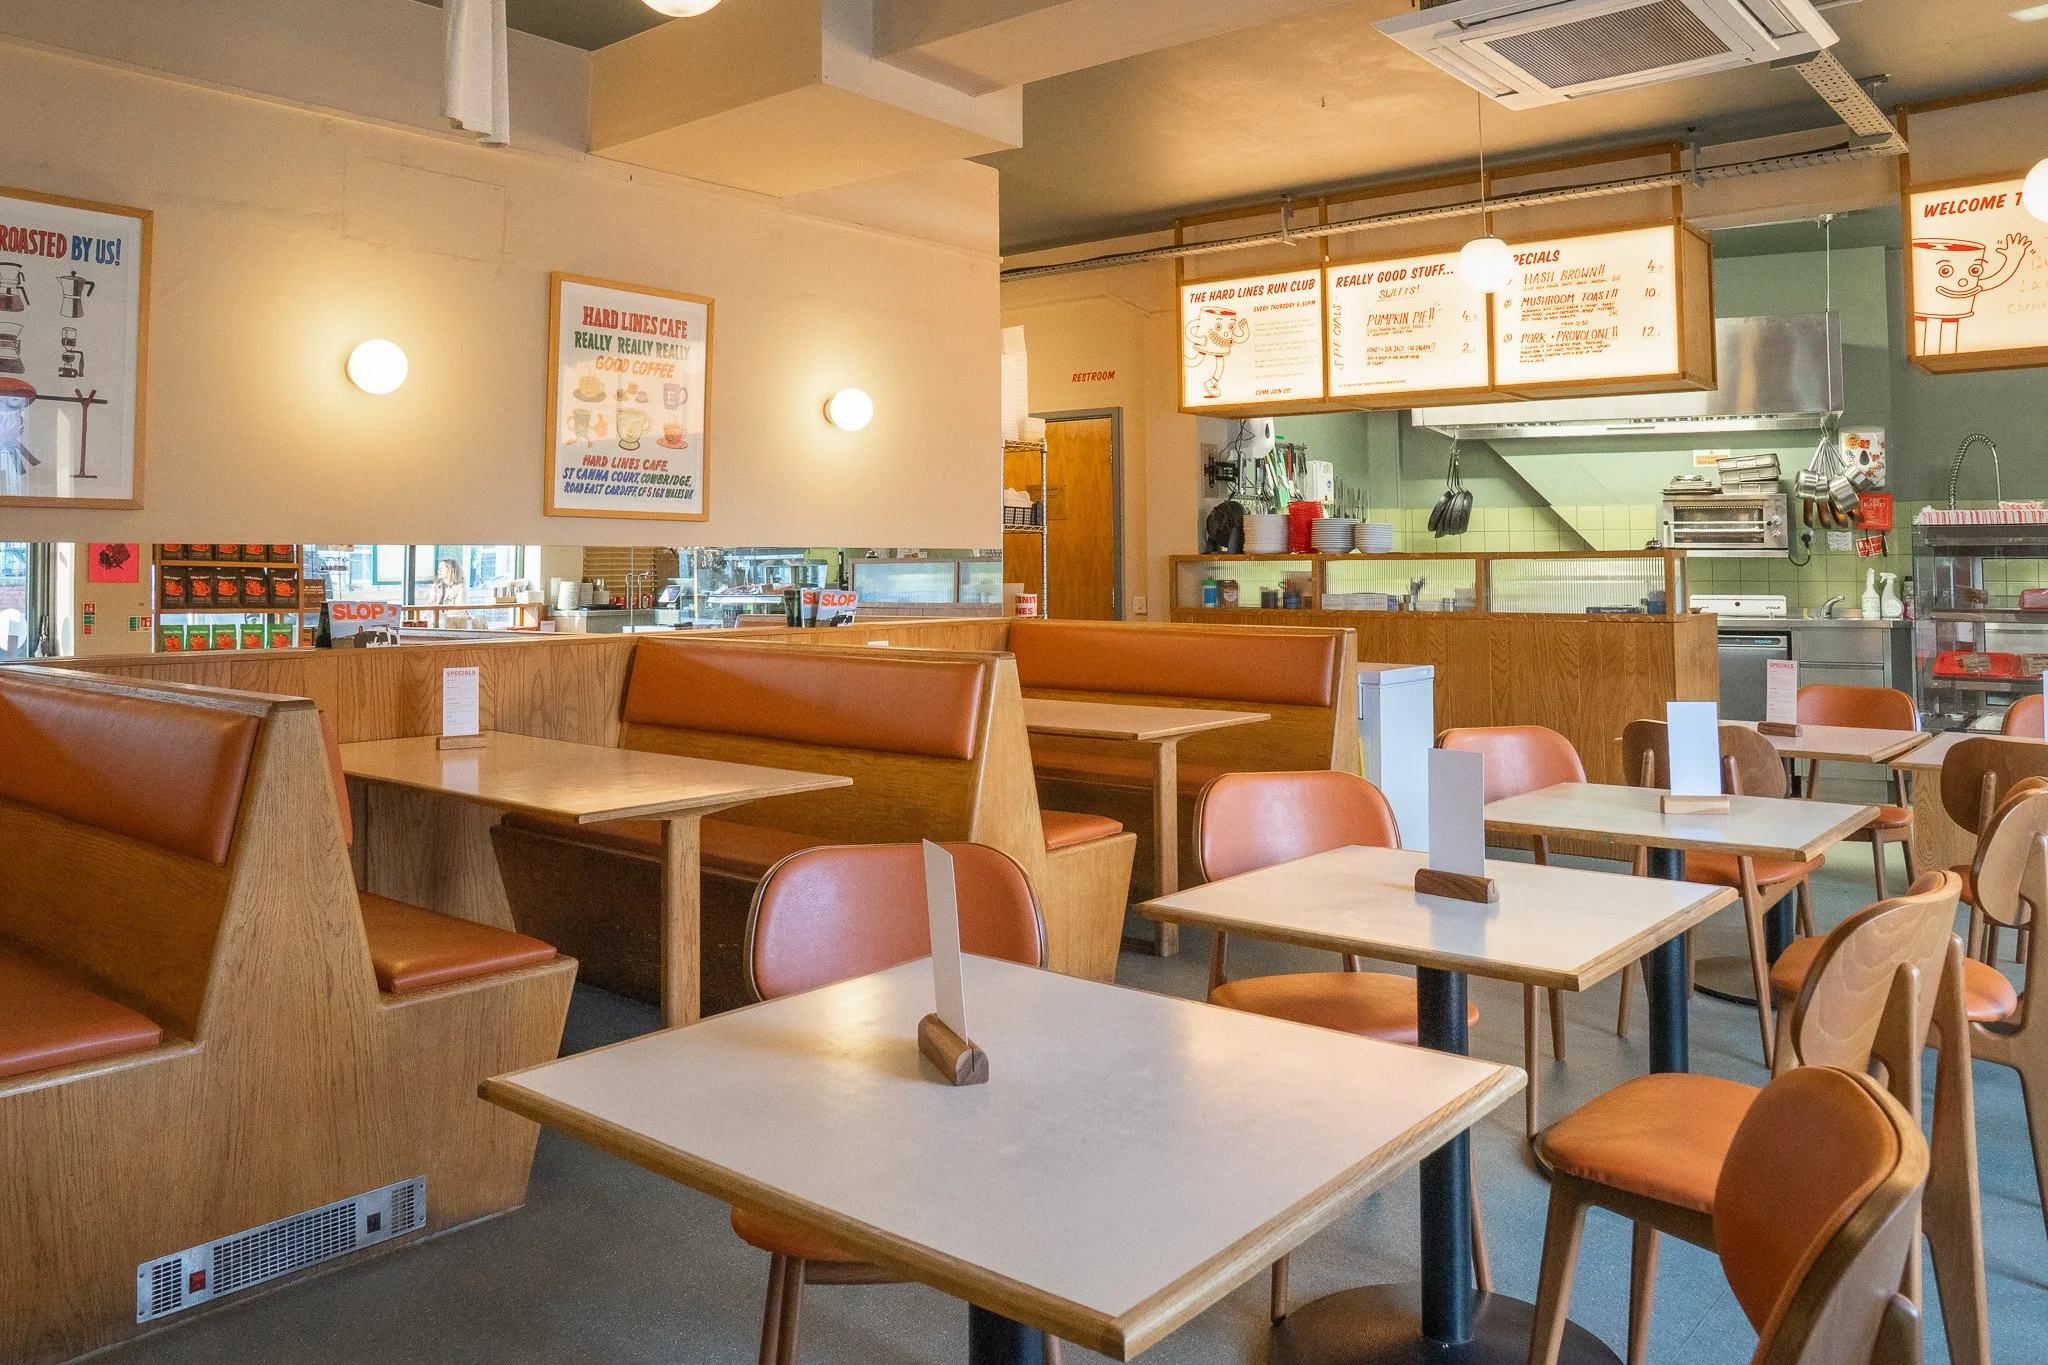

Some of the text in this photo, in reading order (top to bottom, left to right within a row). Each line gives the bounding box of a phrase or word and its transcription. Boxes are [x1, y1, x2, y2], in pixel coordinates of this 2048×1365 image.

[1923, 194, 2007, 218] WELCOME
[0, 224, 122, 266] ROASTED BY US!
[1513, 250, 1560, 266] PECIALS
[1336, 264, 1454, 288] REALLY GOOD STUFF...
[1524, 271, 1554, 285] HASH
[1560, 264, 1606, 282] BROWN!!
[1190, 278, 1316, 304] THE HARD LINES RUN CLUB
[1378, 285, 1420, 299] SWEETS!
[1521, 294, 1575, 307] MUSHROOM
[1581, 288, 1618, 302] TOAST!!
[582, 306, 688, 338] HARD LINES CAFE
[1367, 312, 1409, 327] PUMPKIN
[1412, 307, 1435, 324] PIE!!
[1521, 332, 1546, 344] PORK
[1556, 326, 1618, 342] PROVOLONE!!
[574, 331, 690, 361] REALLY REALLY REALLY
[595, 356, 676, 379] GOOD COFFEE
[1072, 370, 1116, 382] RESTROOM
[1255, 388, 1269, 396] COME
[1271, 387, 1282, 395] JOIN
[582, 455, 608, 467] HARD
[611, 457, 640, 470] LINES
[563, 467, 575, 479] ST
[576, 468, 609, 481] CANNA
[822, 593, 857, 607] SLOP
[332, 603, 384, 621] SLOP
